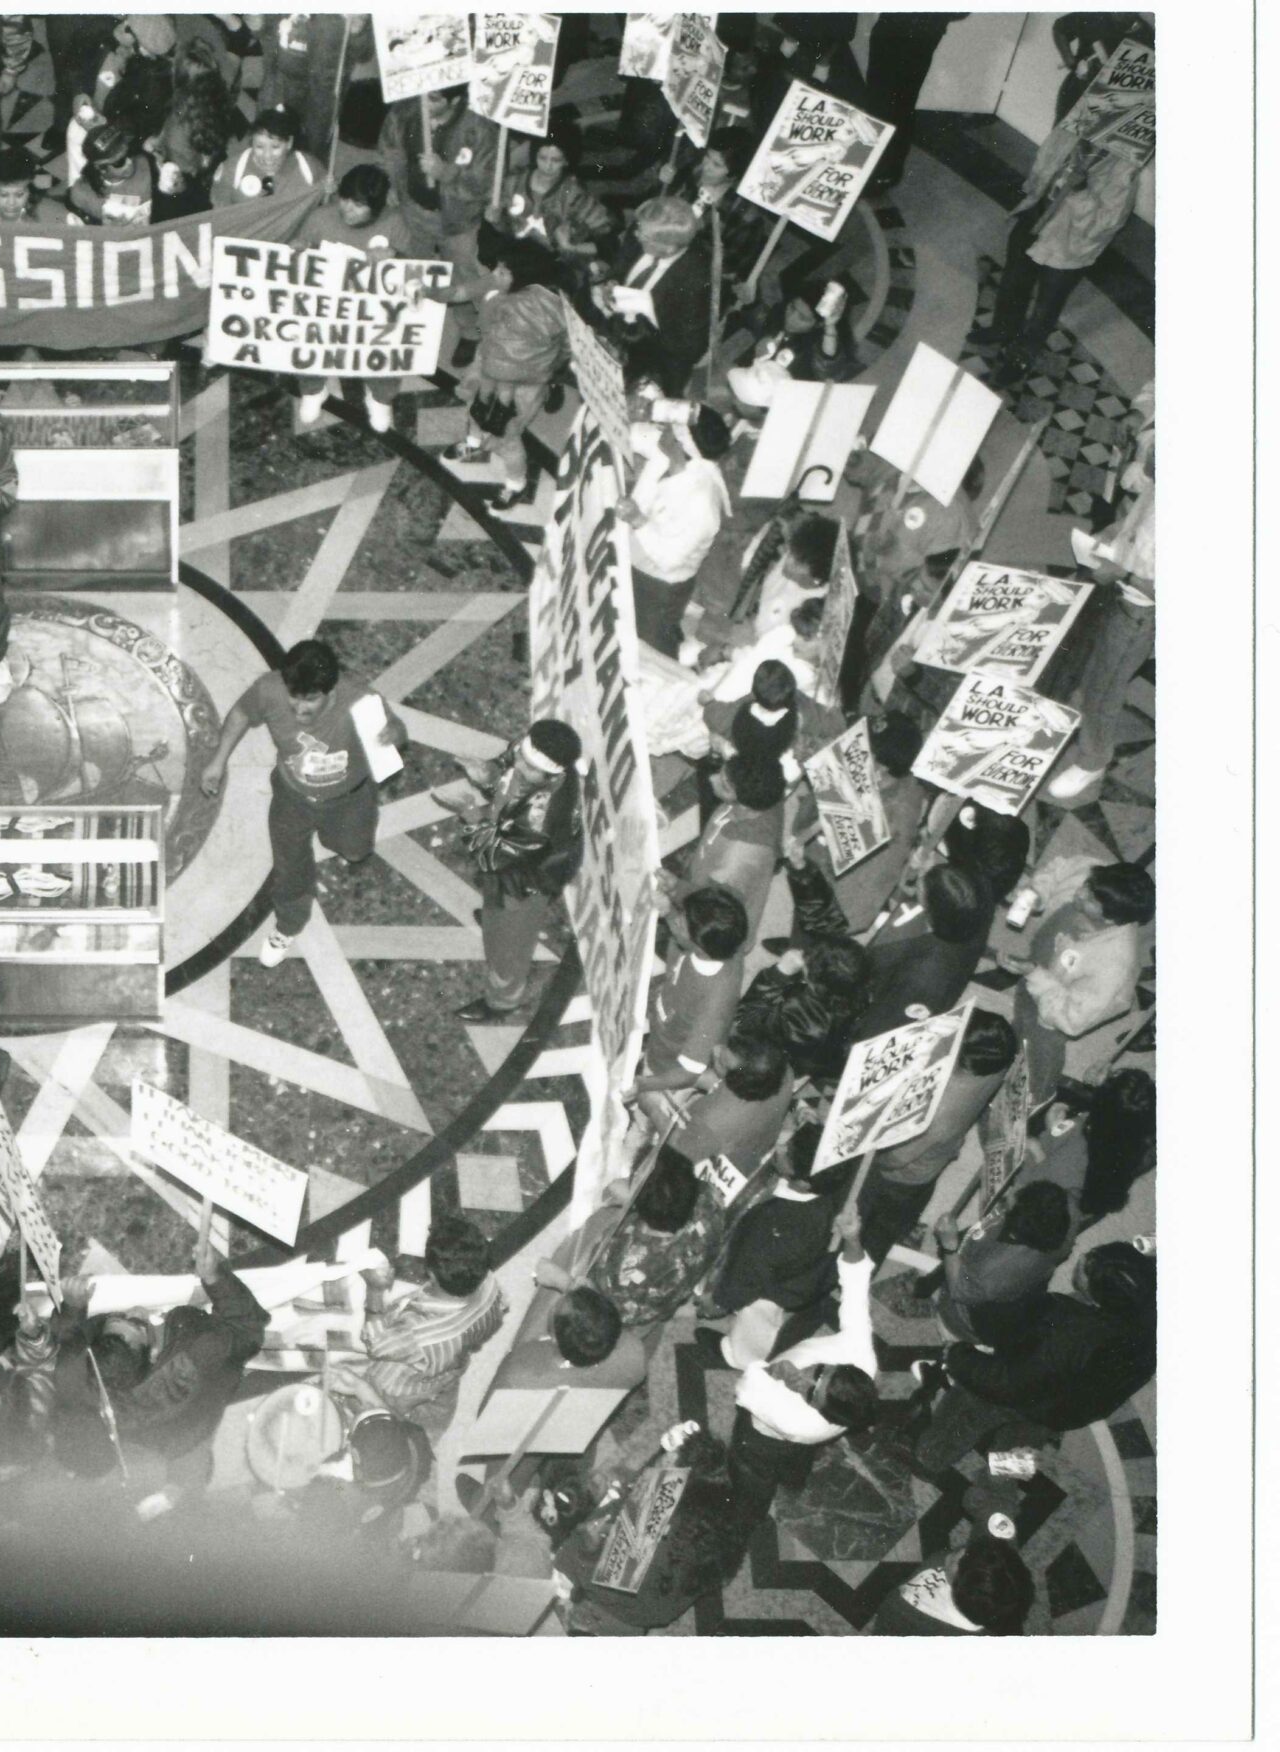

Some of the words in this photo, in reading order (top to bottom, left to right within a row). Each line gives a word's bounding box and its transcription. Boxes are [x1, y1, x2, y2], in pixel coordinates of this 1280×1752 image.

[484, 19, 524, 31] SHOULD
[484, 31, 521, 49] WORK
[1118, 48, 1150, 64] LA
[519, 70, 548, 88] FOR
[1114, 62, 1156, 78] SHOUL
[796, 95, 827, 114] LA
[793, 111, 847, 129] SHOULD
[1134, 110, 1156, 127] FO
[787, 122, 838, 142] WORK
[816, 166, 854, 188] FOR
[224, 244, 328, 288] THE
[341, 257, 449, 297] RIGT
[219, 283, 256, 301] TO
[268, 287, 407, 324] FREELY
[221, 313, 427, 346] ORGANIZE
[234, 343, 262, 365] A
[290, 346, 417, 372] UNION
[976, 573, 1011, 587] LA
[973, 585, 1034, 597] SHOULD
[969, 596, 1025, 612] WORK
[1006, 629, 1051, 644] FOR
[585, 507, 638, 813] DEMAND
[969, 679, 1005, 699] LA
[966, 694, 1030, 715] SHOULD
[960, 704, 1020, 729] WORK
[998, 751, 1044, 772] FOR
[864, 1035, 897, 1065] LA
[859, 1051, 914, 1092] WORK
